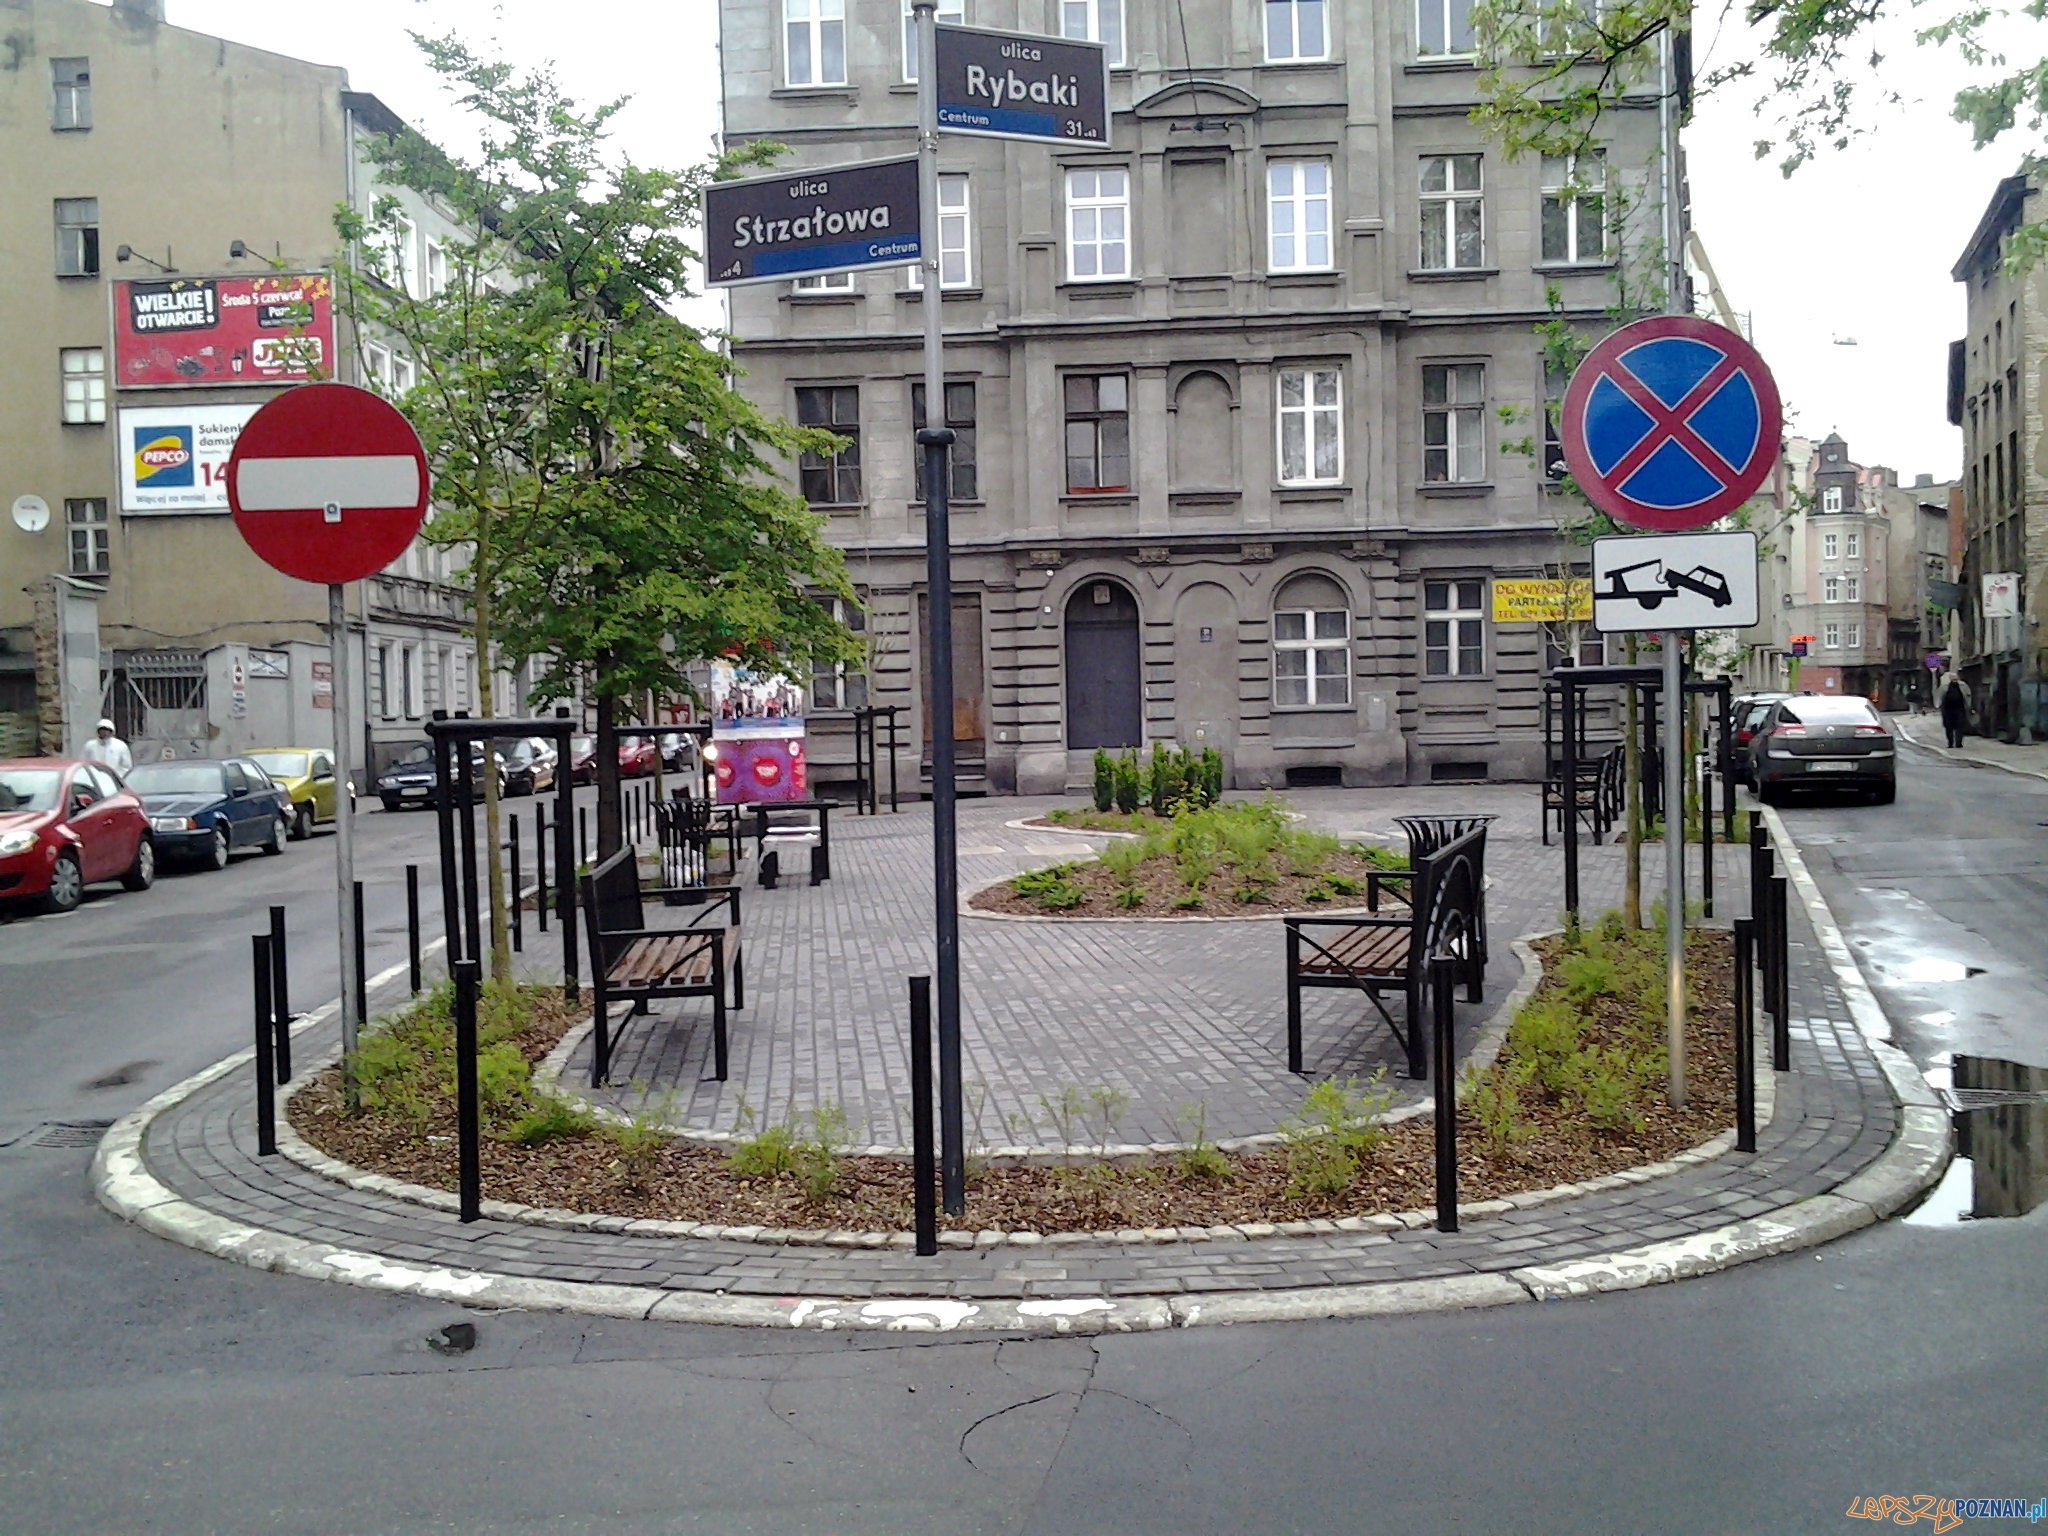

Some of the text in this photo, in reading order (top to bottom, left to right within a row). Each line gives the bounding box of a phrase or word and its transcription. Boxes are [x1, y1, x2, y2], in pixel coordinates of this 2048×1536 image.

[1000, 42, 1042, 61] ulica
[966, 64, 1078, 107] Rybaki
[938, 109, 989, 126] Centrum
[789, 180, 829, 198] ulica
[733, 205, 890, 248] Strzałowa
[869, 242, 918, 257] Centrum
[134, 291, 204, 313] WIELKIE
[252, 292, 259, 305] 5
[137, 309, 206, 329] OTWARCIE
[144, 450, 185, 463] PEPCO
